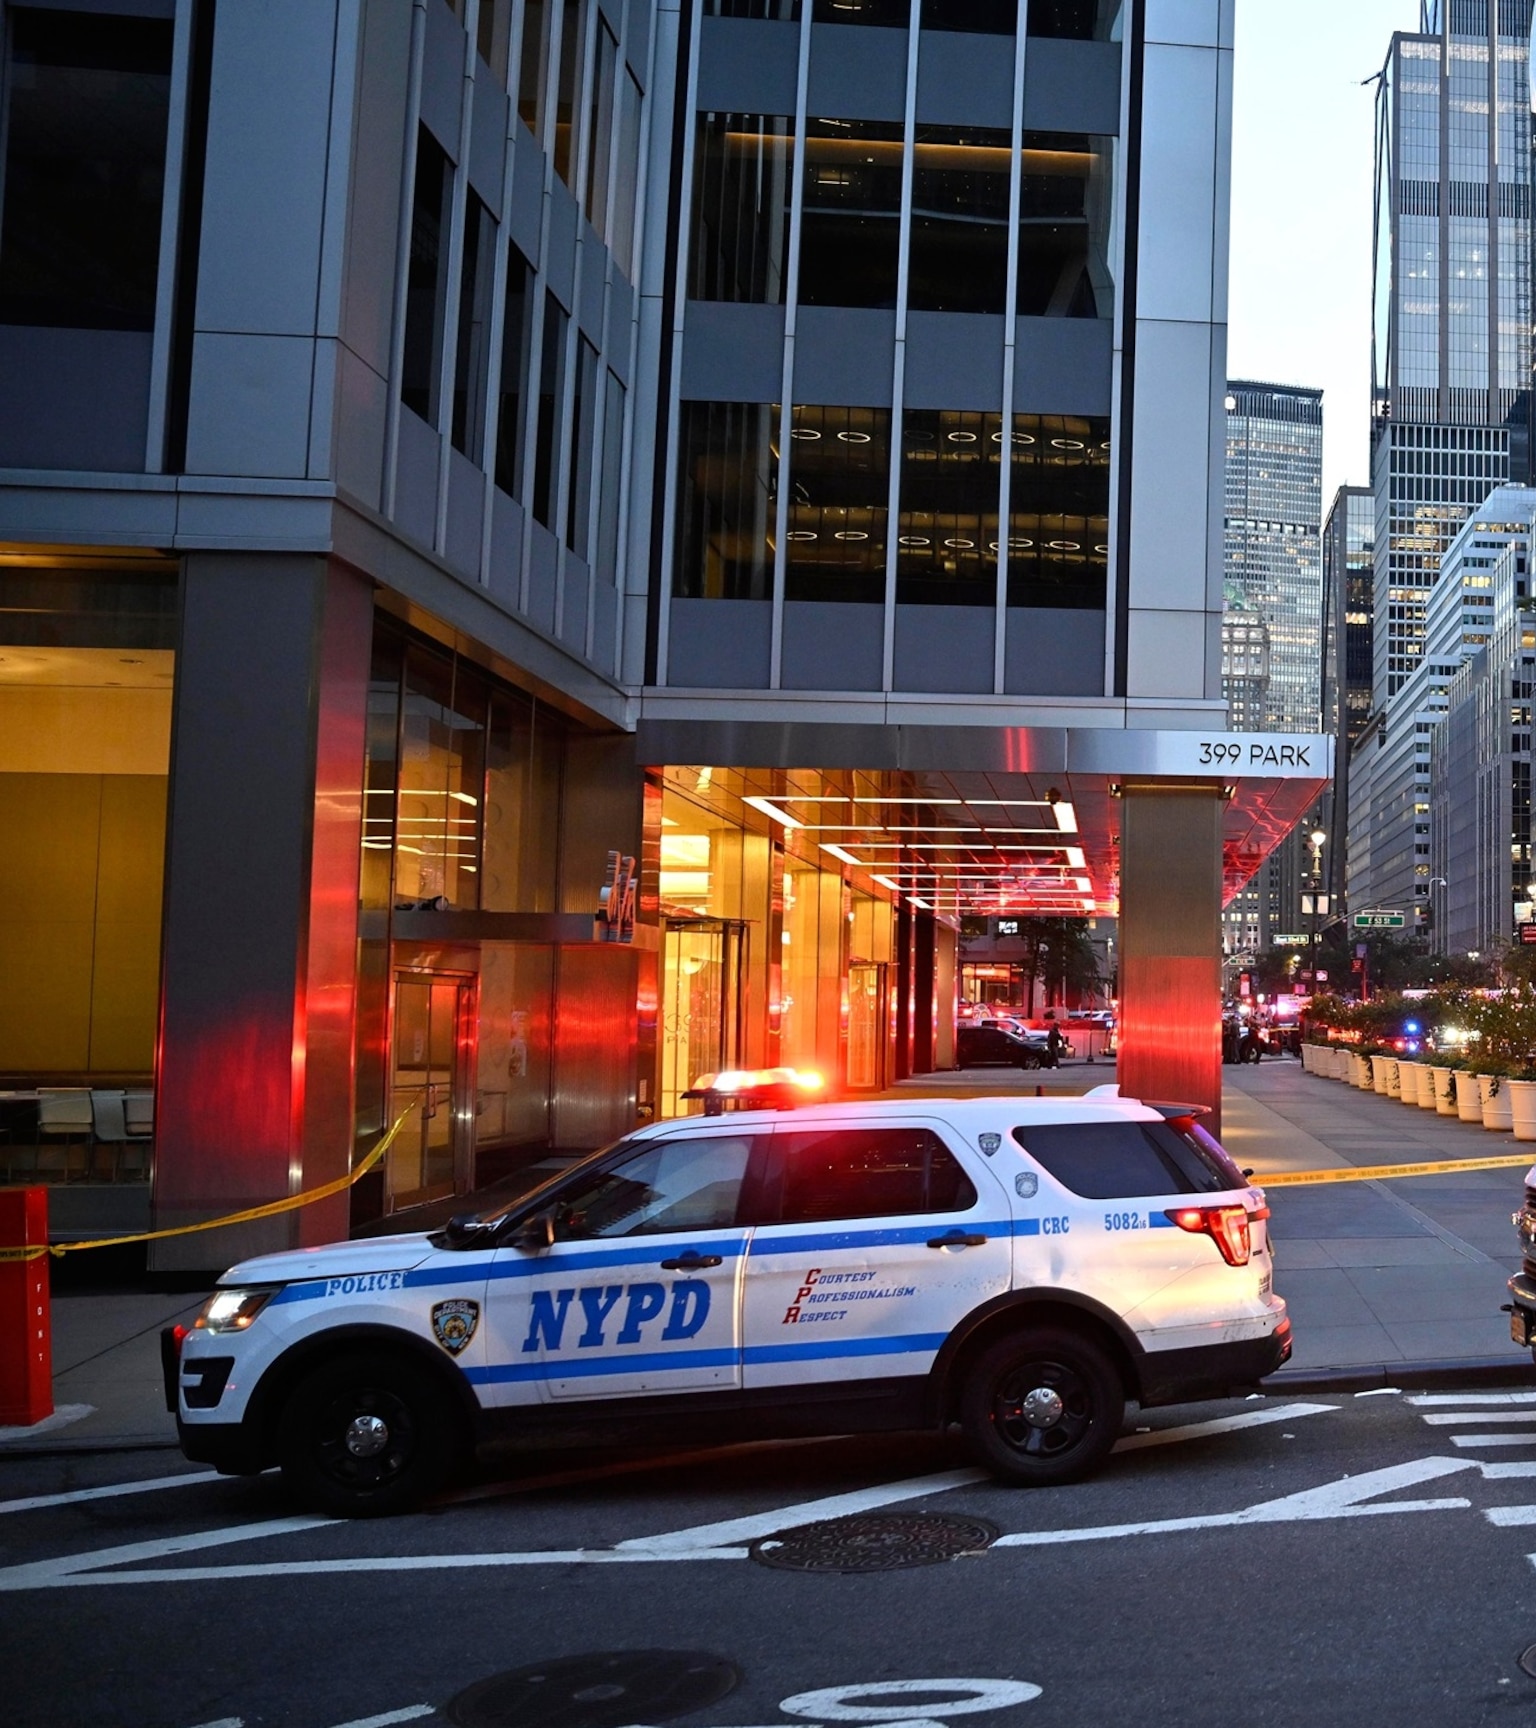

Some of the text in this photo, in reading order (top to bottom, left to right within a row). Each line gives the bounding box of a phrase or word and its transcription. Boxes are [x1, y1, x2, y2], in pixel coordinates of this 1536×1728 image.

[1199, 743, 1310, 766] 399 PARK
[1042, 1216, 1069, 1235] CRC
[1104, 1212, 1138, 1231] 5082
[328, 1272, 402, 1297] POLICE
[805, 1268, 876, 1285] COURTESY
[793, 1286, 916, 1304] PROFESSIONALISM
[522, 1279, 712, 1352] NYPD
[782, 1306, 847, 1324] RESPECT
